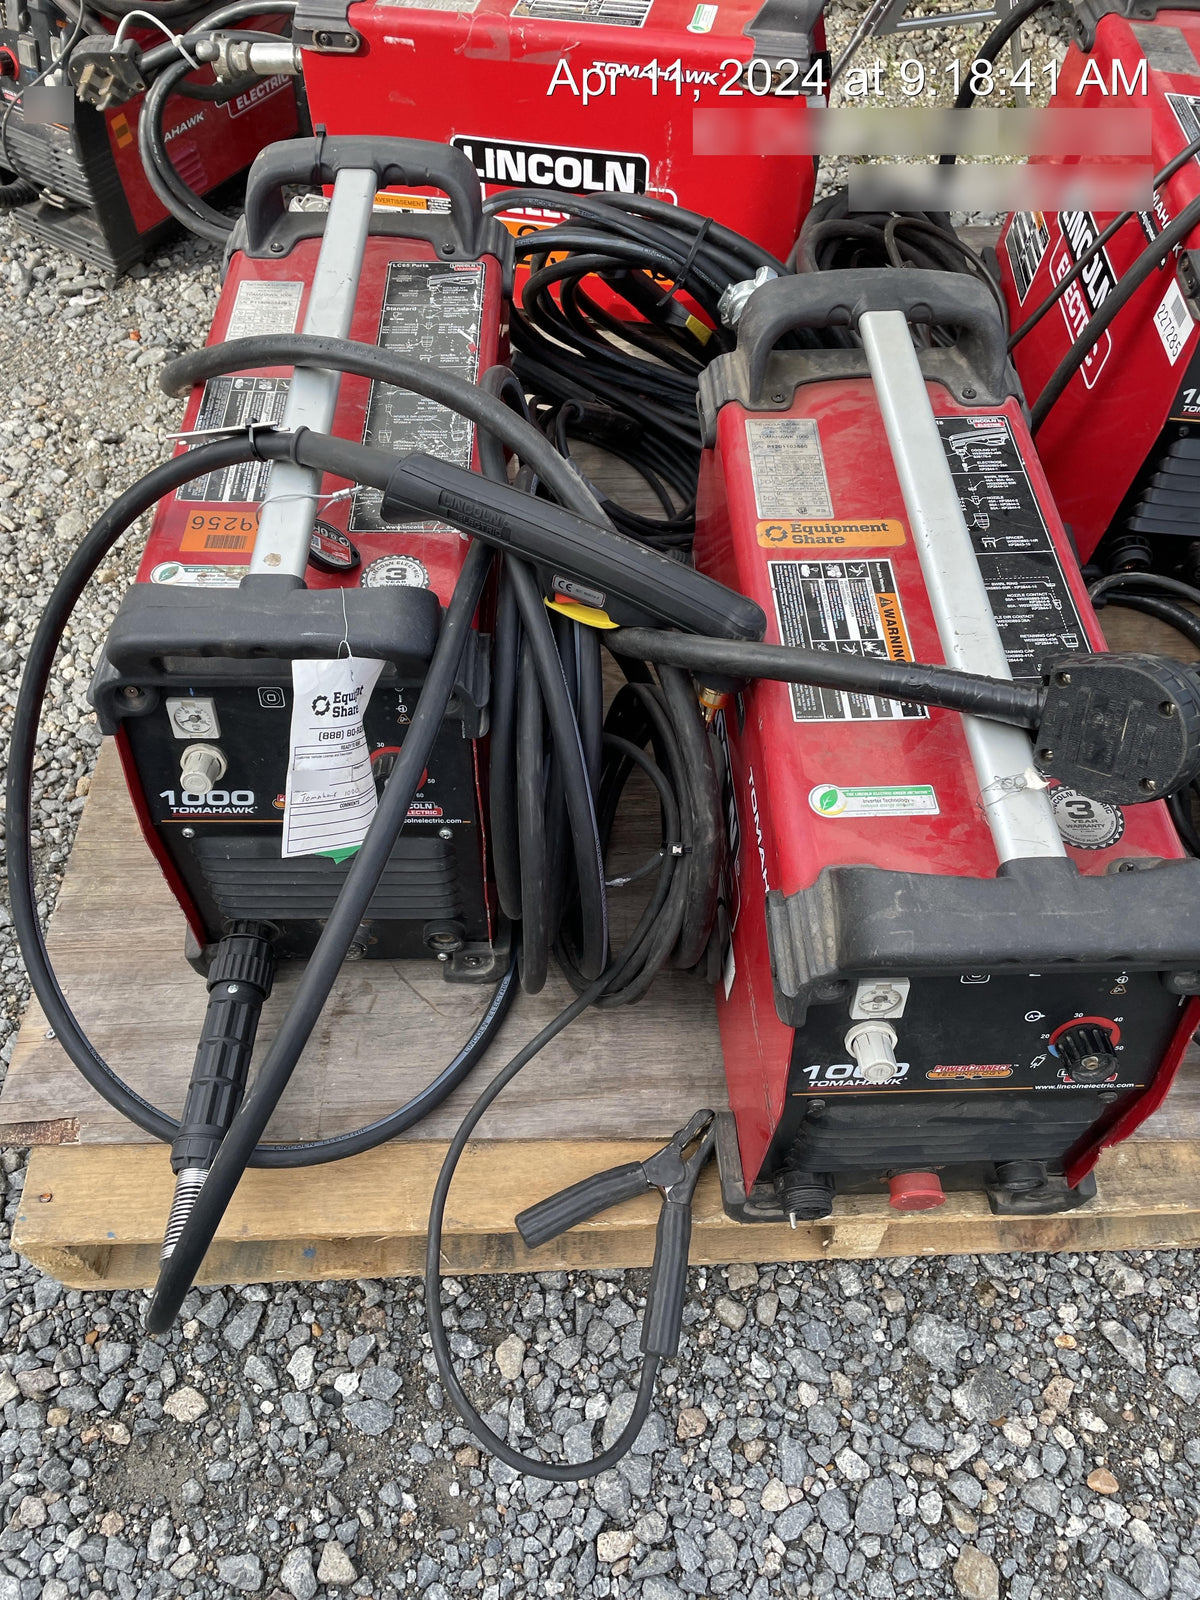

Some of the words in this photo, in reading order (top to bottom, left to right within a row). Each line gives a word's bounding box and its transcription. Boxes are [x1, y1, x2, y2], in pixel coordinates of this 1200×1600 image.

[236, 75, 290, 110] ELECTRIC
[164, 111, 205, 143] AHAWK
[462, 145, 636, 194] LINCOLN
[1156, 303, 1182, 357] 227285
[444, 492, 501, 528] LINCOLN
[191, 515, 259, 532] 9256
[456, 514, 502, 537] ELECTRIC
[790, 521, 890, 535] Equipment
[792, 534, 846, 544] Share
[385, 567, 407, 581] 3
[332, 705, 359, 718] Share
[318, 730, 345, 742] (888)
[160, 790, 255, 806] 1000
[339, 800, 360, 809] COMMENTS
[170, 806, 255, 814] TOMAHAWK
[1065, 800, 1095, 819] 3
[749, 766, 770, 893] TOMAH
[464, 1021, 489, 1053] LINCOLN
[488, 980, 510, 1018] ELECTRIC
[808, 1078, 902, 1087] TOMAHAWK
[1034, 1082, 1135, 1090] www.lincolnelectric.com
[274, 1142, 316, 1151] LINCOLN
[322, 1128, 367, 1145] ELECTRIC
